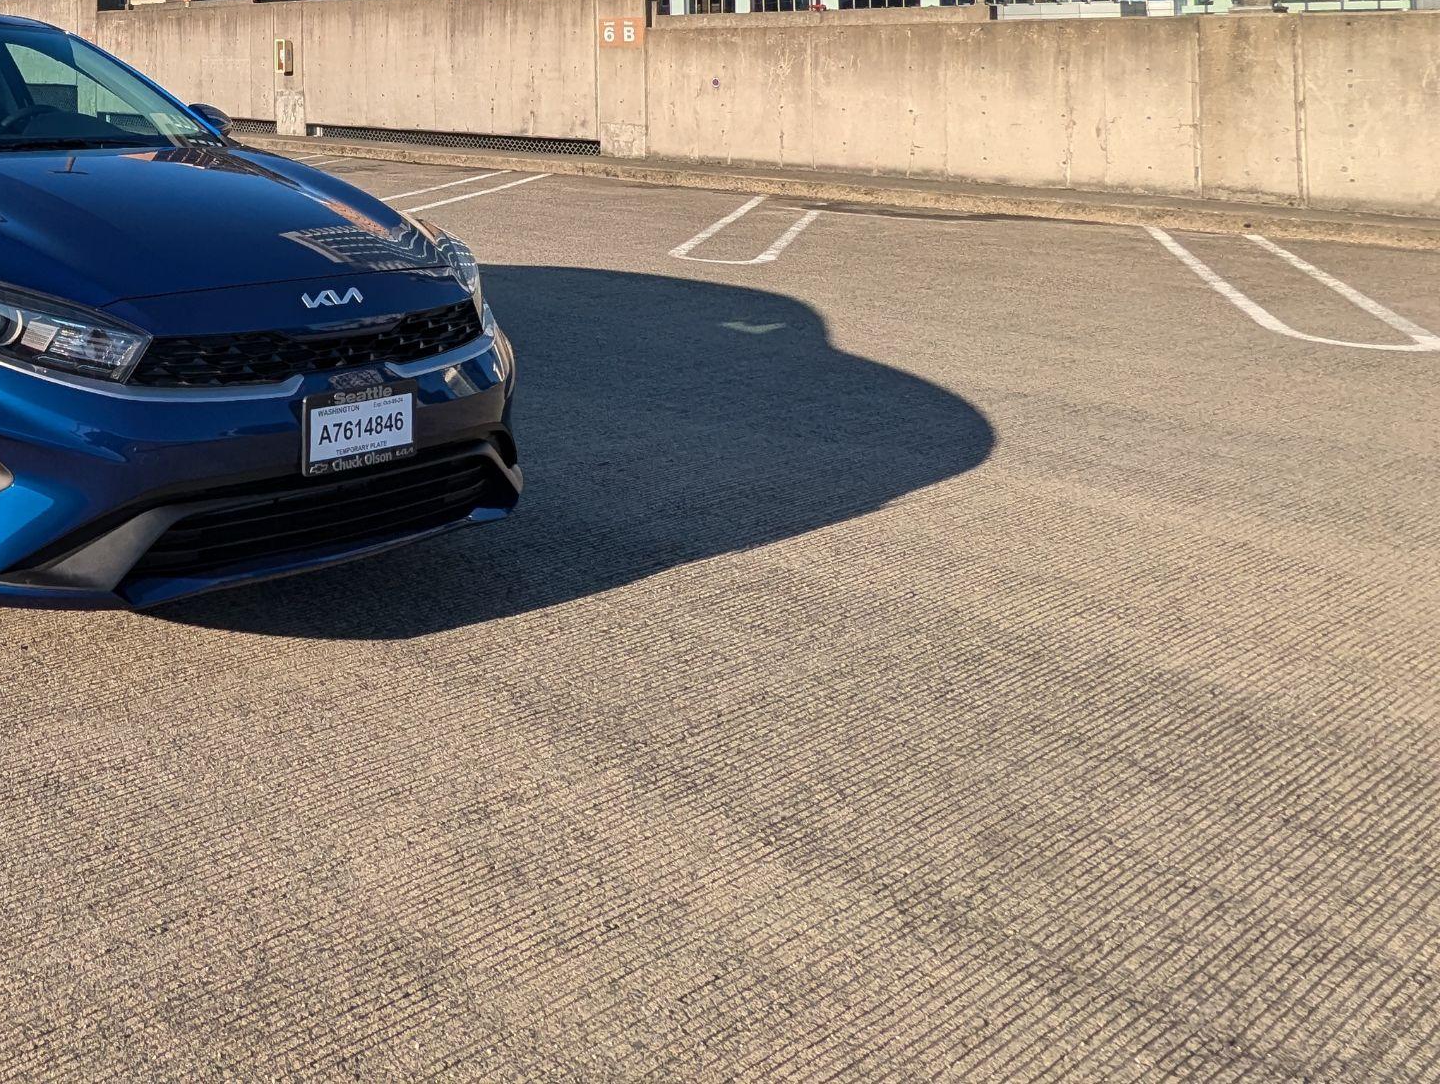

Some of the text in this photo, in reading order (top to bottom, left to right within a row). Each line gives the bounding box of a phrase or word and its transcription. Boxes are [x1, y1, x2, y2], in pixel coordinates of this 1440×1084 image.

[603, 26, 635, 43] 6 B
[301, 287, 364, 309] KIA
[333, 385, 393, 405] Seattle
[317, 404, 361, 417] WASHINGTON
[318, 411, 404, 445] A7614846
[336, 440, 388, 456] TEMPORARY PLATE
[332, 455, 363, 472] Chuck
[364, 451, 393, 466] Olson
